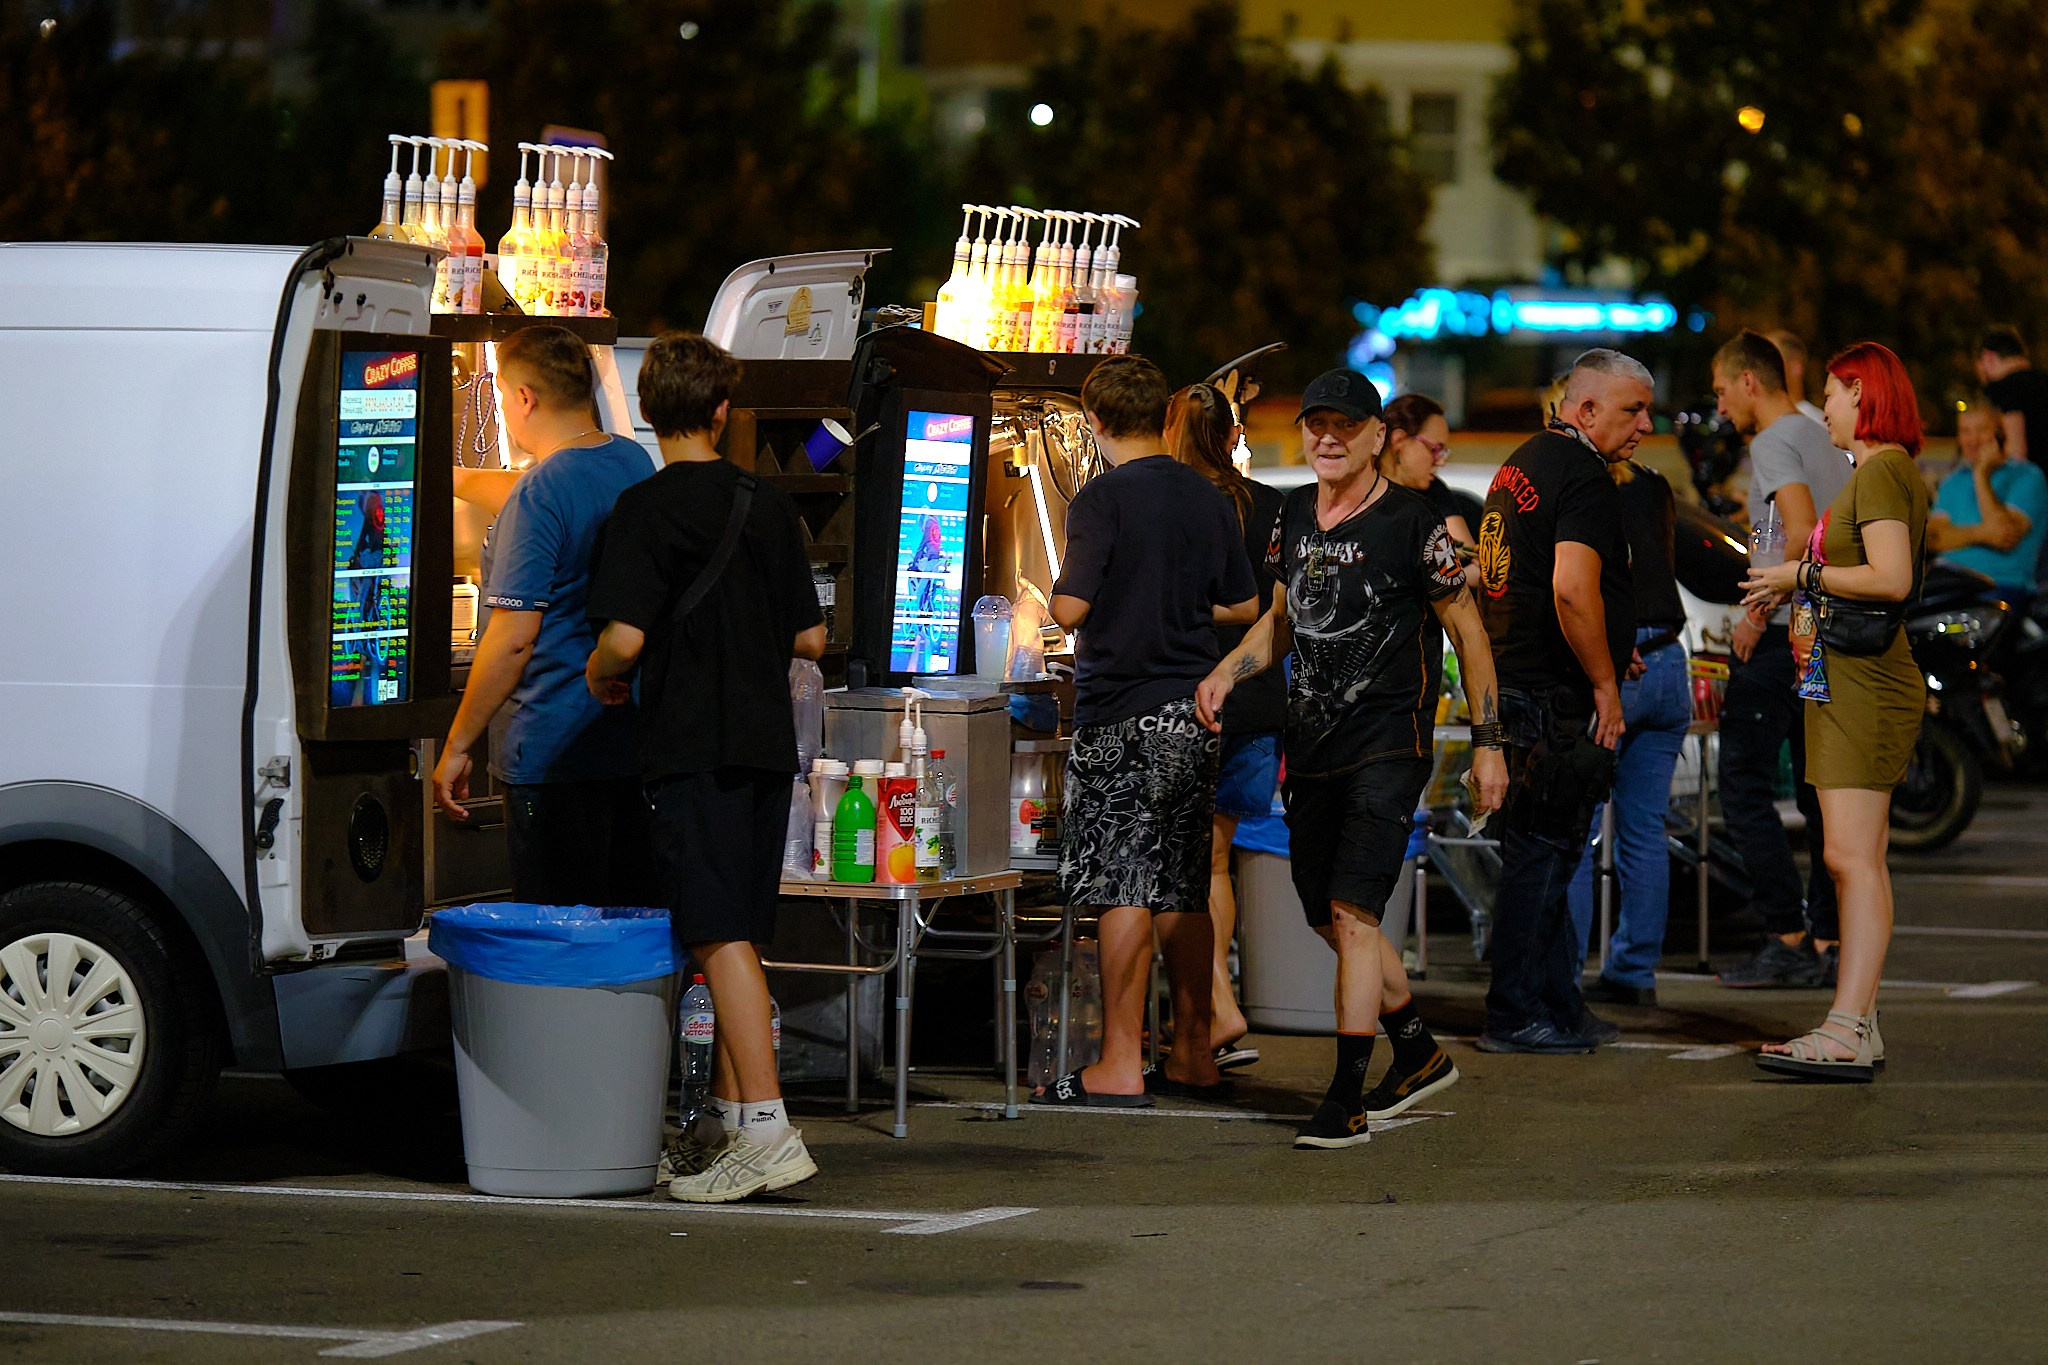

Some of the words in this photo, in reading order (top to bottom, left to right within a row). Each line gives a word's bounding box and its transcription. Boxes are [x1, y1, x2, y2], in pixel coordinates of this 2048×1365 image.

[364, 363, 390, 385] CRAZY
[497, 597, 523, 607] GOOD
[899, 807, 914, 816] 100
